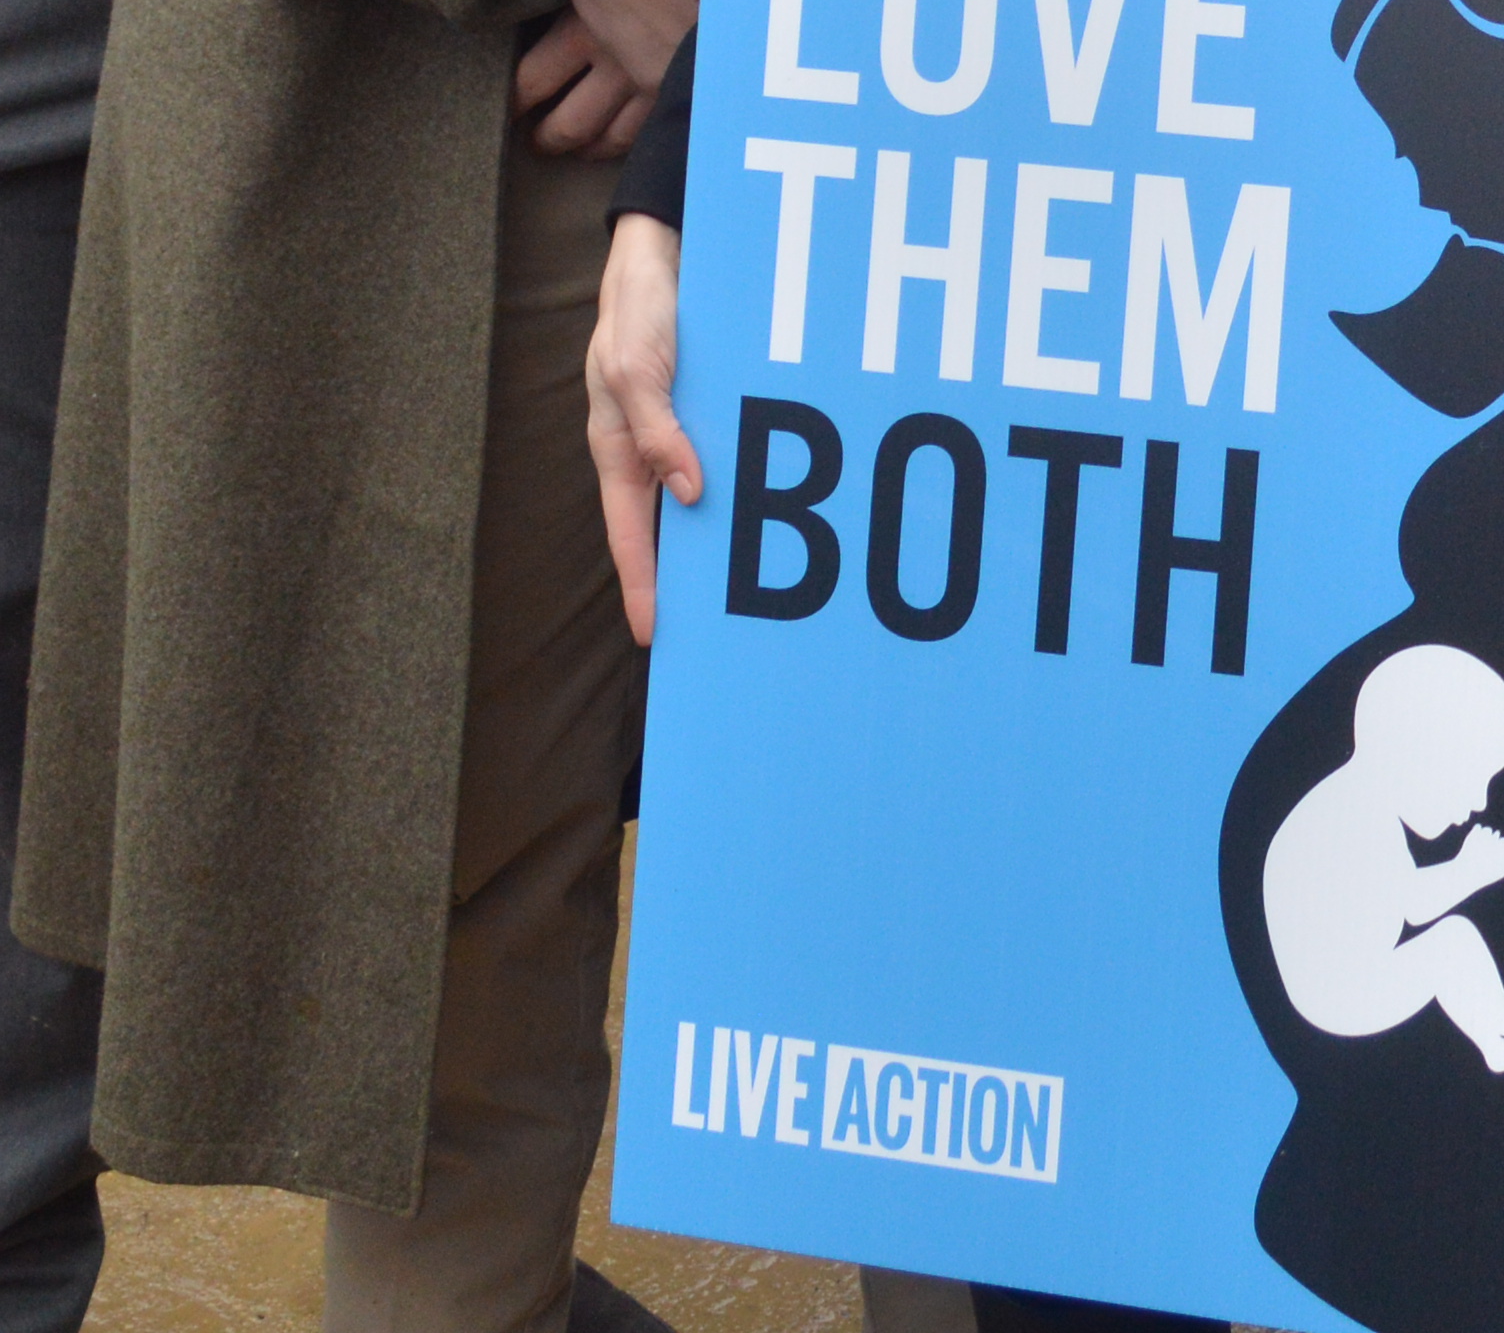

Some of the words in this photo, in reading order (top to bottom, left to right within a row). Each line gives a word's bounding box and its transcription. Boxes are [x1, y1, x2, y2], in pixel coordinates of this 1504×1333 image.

[743, 137, 1292, 413] THEM
[725, 395, 1261, 676] BOTH
[672, 1021, 816, 1146] LIVE
[832, 1056, 1052, 1173] ACTION
